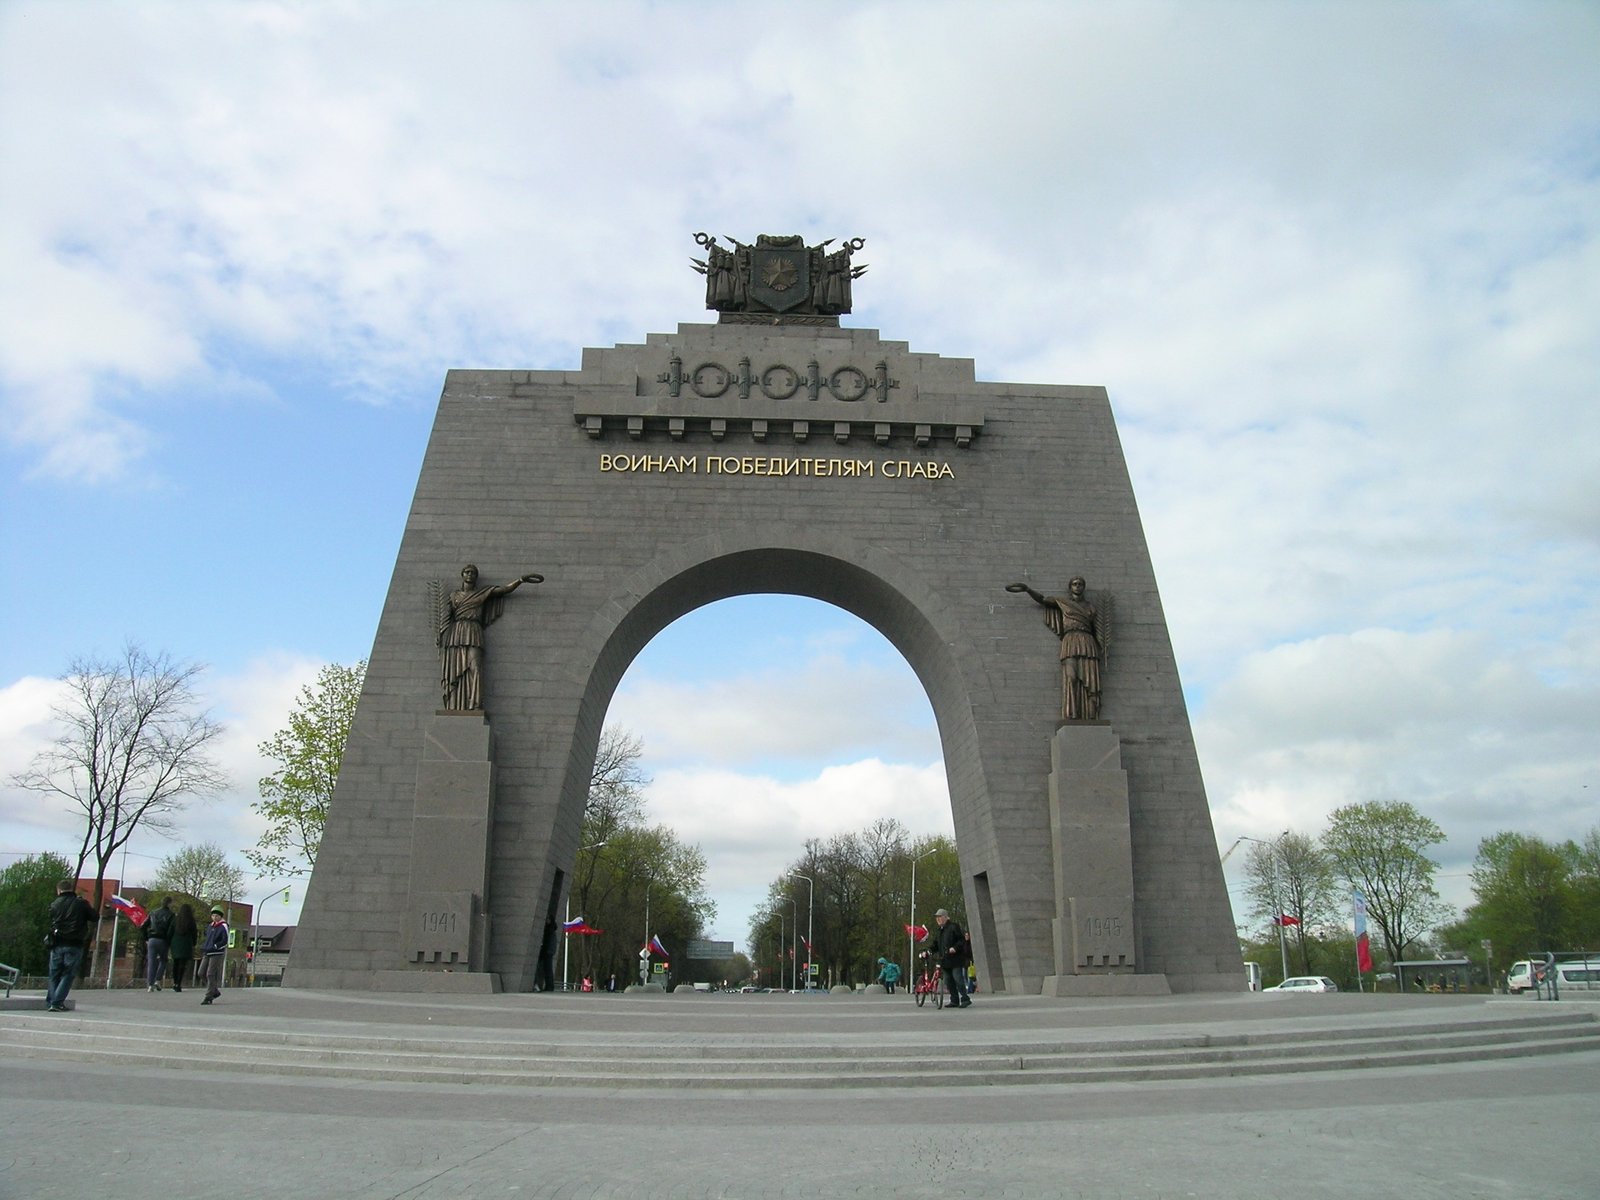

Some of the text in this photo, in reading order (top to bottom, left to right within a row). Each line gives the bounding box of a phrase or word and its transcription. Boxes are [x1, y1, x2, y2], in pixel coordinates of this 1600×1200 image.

[600, 454, 955, 479] ВОИНАМ ПОБЕДИТЕЛЯМ СЛАВА
[422, 912, 456, 933] 1941
[1087, 917, 1121, 937] 1945
